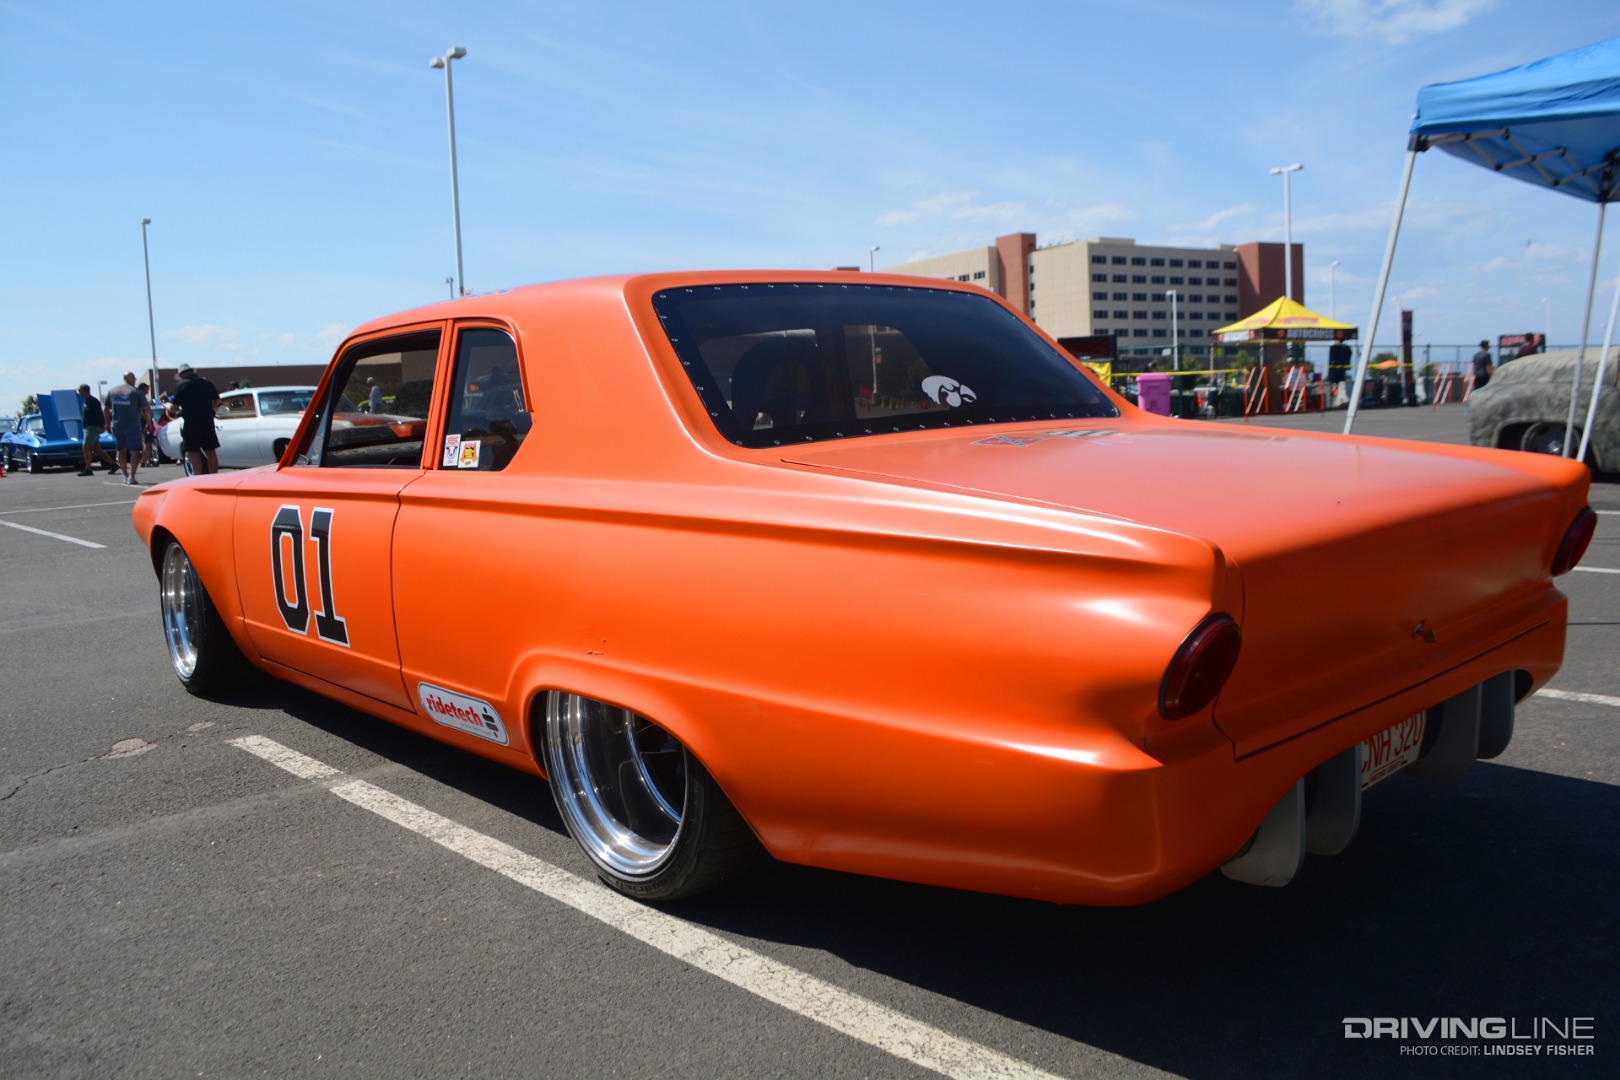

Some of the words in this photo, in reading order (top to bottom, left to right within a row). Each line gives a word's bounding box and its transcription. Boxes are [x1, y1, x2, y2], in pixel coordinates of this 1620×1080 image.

[270, 504, 350, 648] 01
[426, 694, 483, 727] ridetech
[1394, 711, 1424, 756] 320
